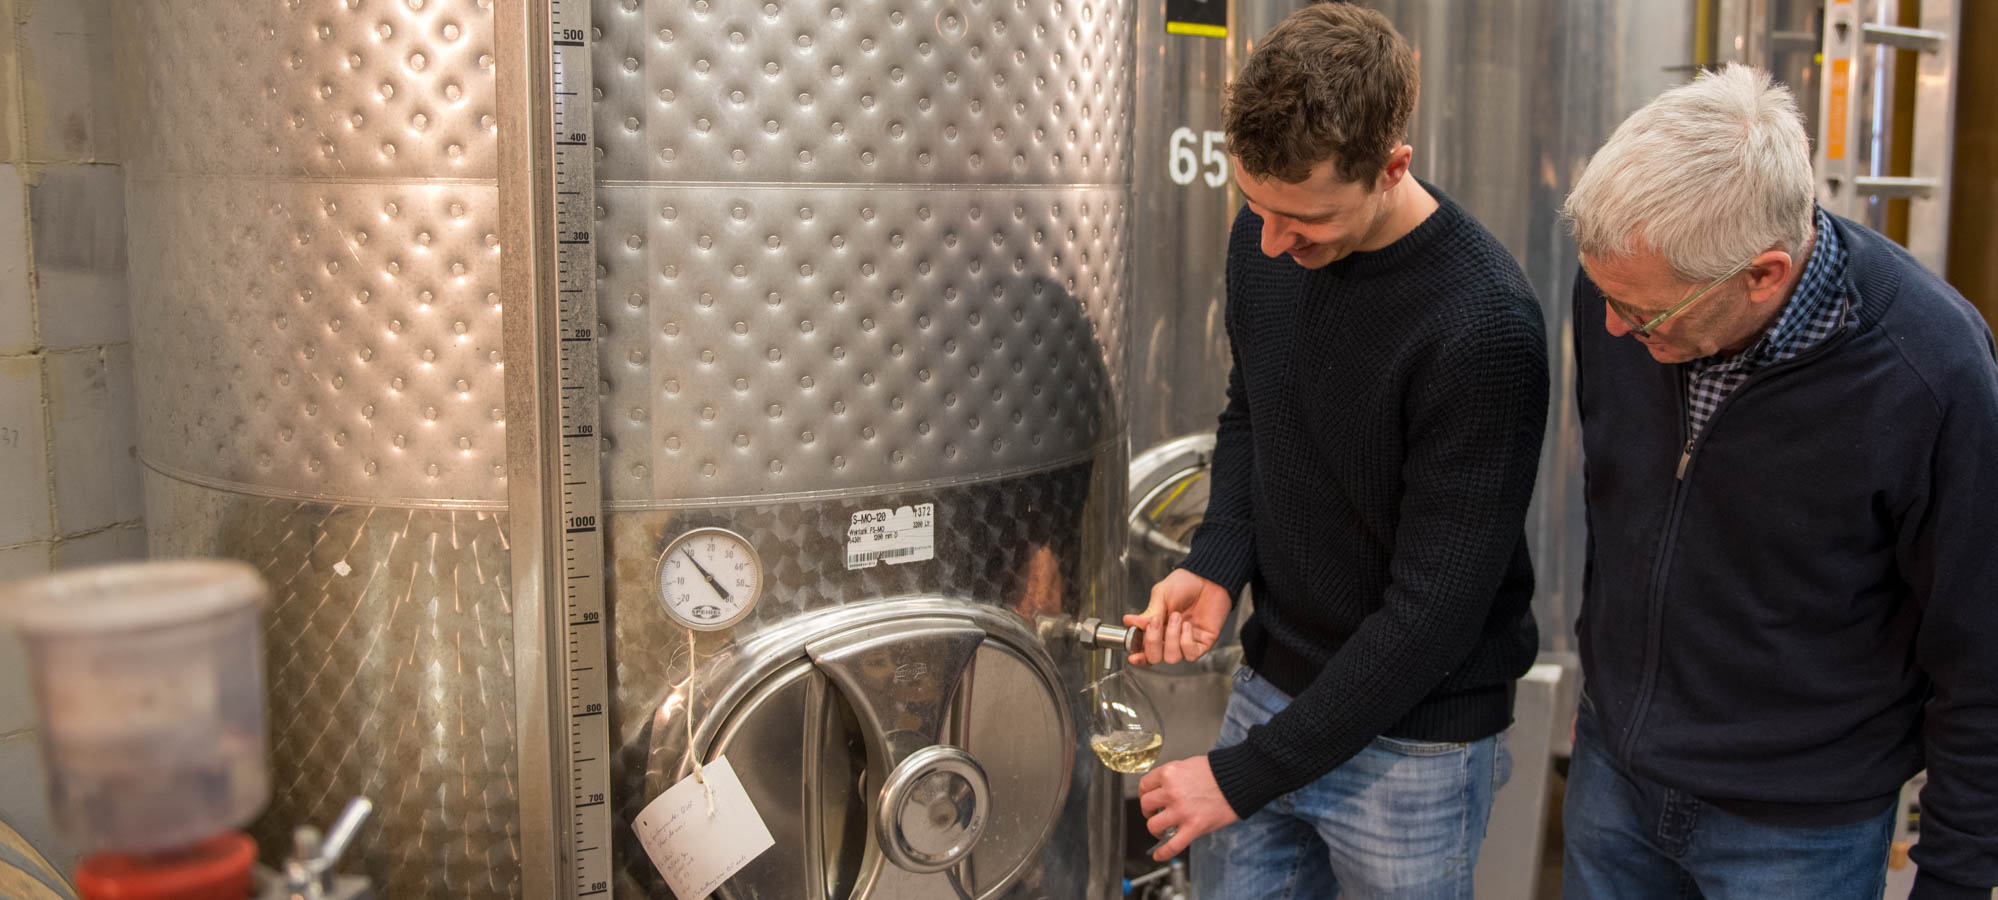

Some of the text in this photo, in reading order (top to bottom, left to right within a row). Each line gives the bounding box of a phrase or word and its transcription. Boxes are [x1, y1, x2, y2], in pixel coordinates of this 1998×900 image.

[563, 29, 584, 41] 500
[570, 133, 587, 142] 400
[1169, 126, 1228, 188] 65
[573, 231, 589, 241] 300
[575, 329, 591, 338] 200
[577, 425, 593, 434] 100
[569, 517, 596, 527] 1000
[707, 544, 716, 552] 20
[736, 579, 745, 587] 50
[583, 612, 599, 621] 900
[586, 703, 602, 712] 800
[588, 793, 604, 802] 700
[591, 882, 607, 891] 600
